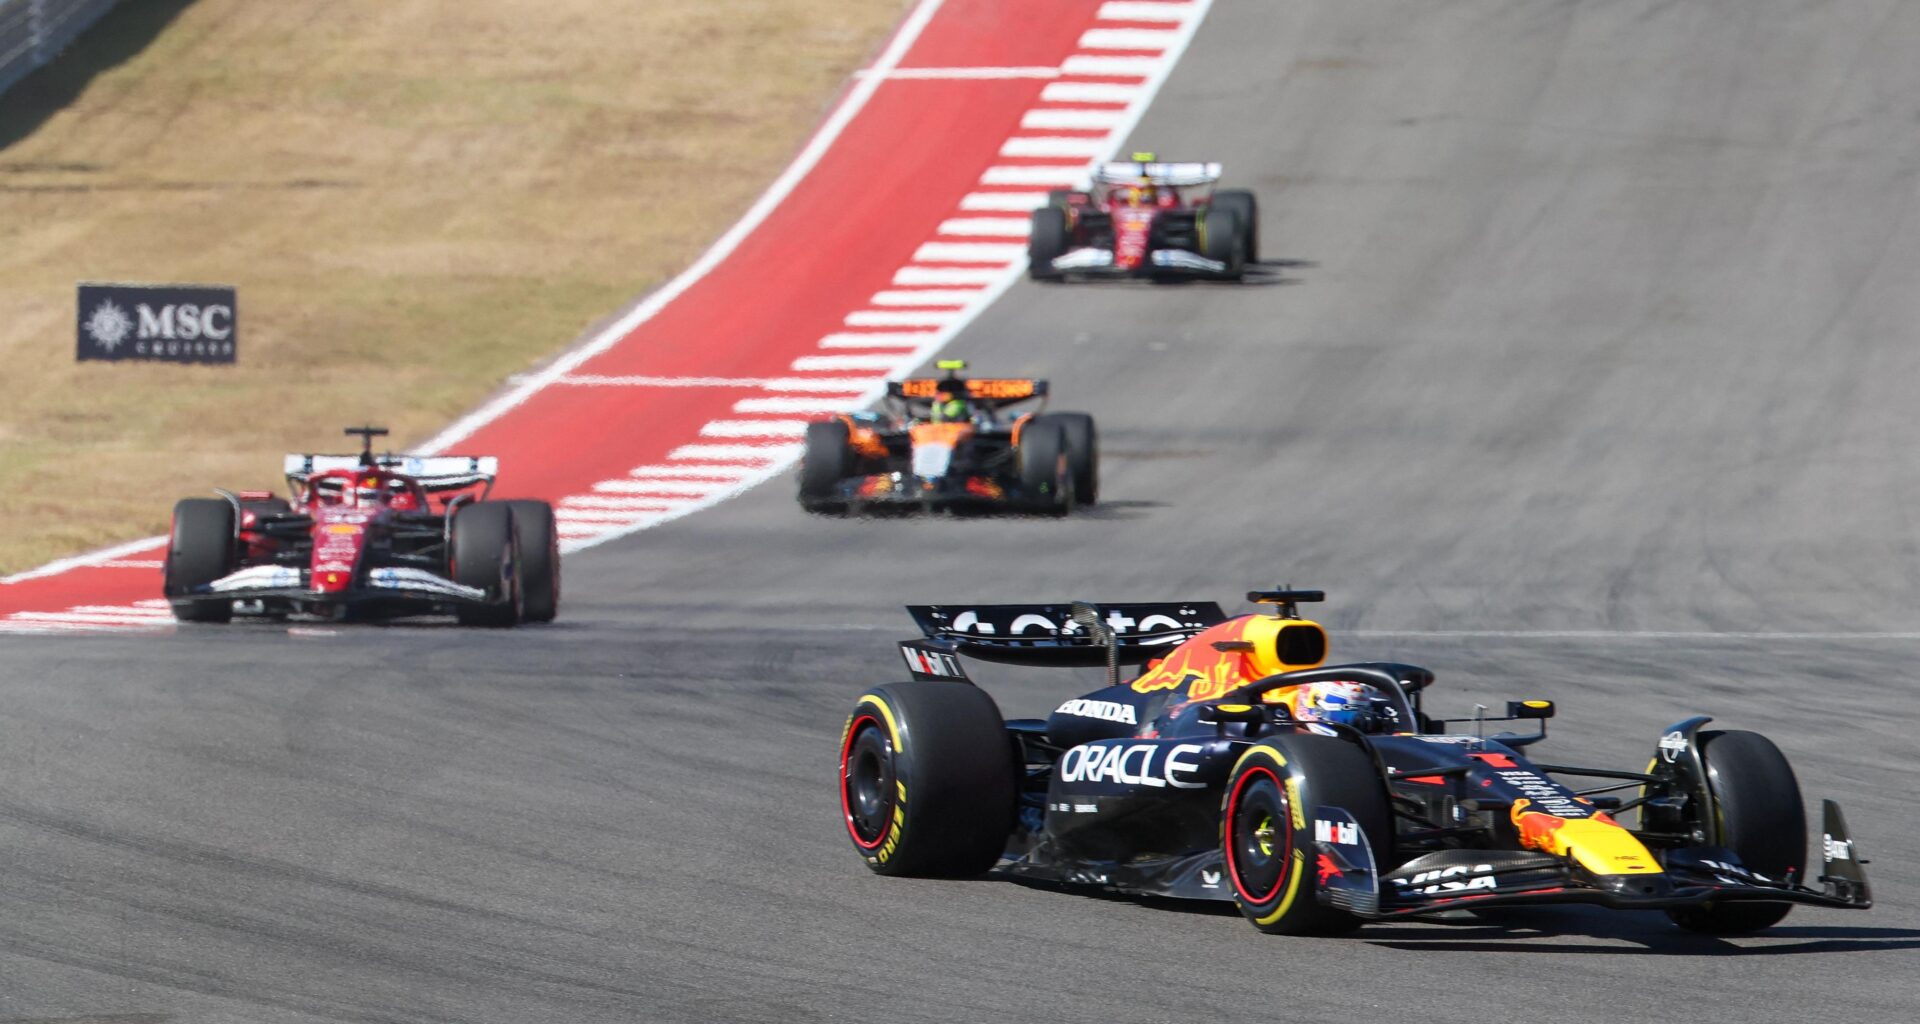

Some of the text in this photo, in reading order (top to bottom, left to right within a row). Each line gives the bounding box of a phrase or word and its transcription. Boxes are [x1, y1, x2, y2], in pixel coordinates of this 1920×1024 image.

[135, 303, 231, 340] MSC
[1054, 699, 1138, 725] HONDA
[1061, 744, 1208, 789] ORACLE
